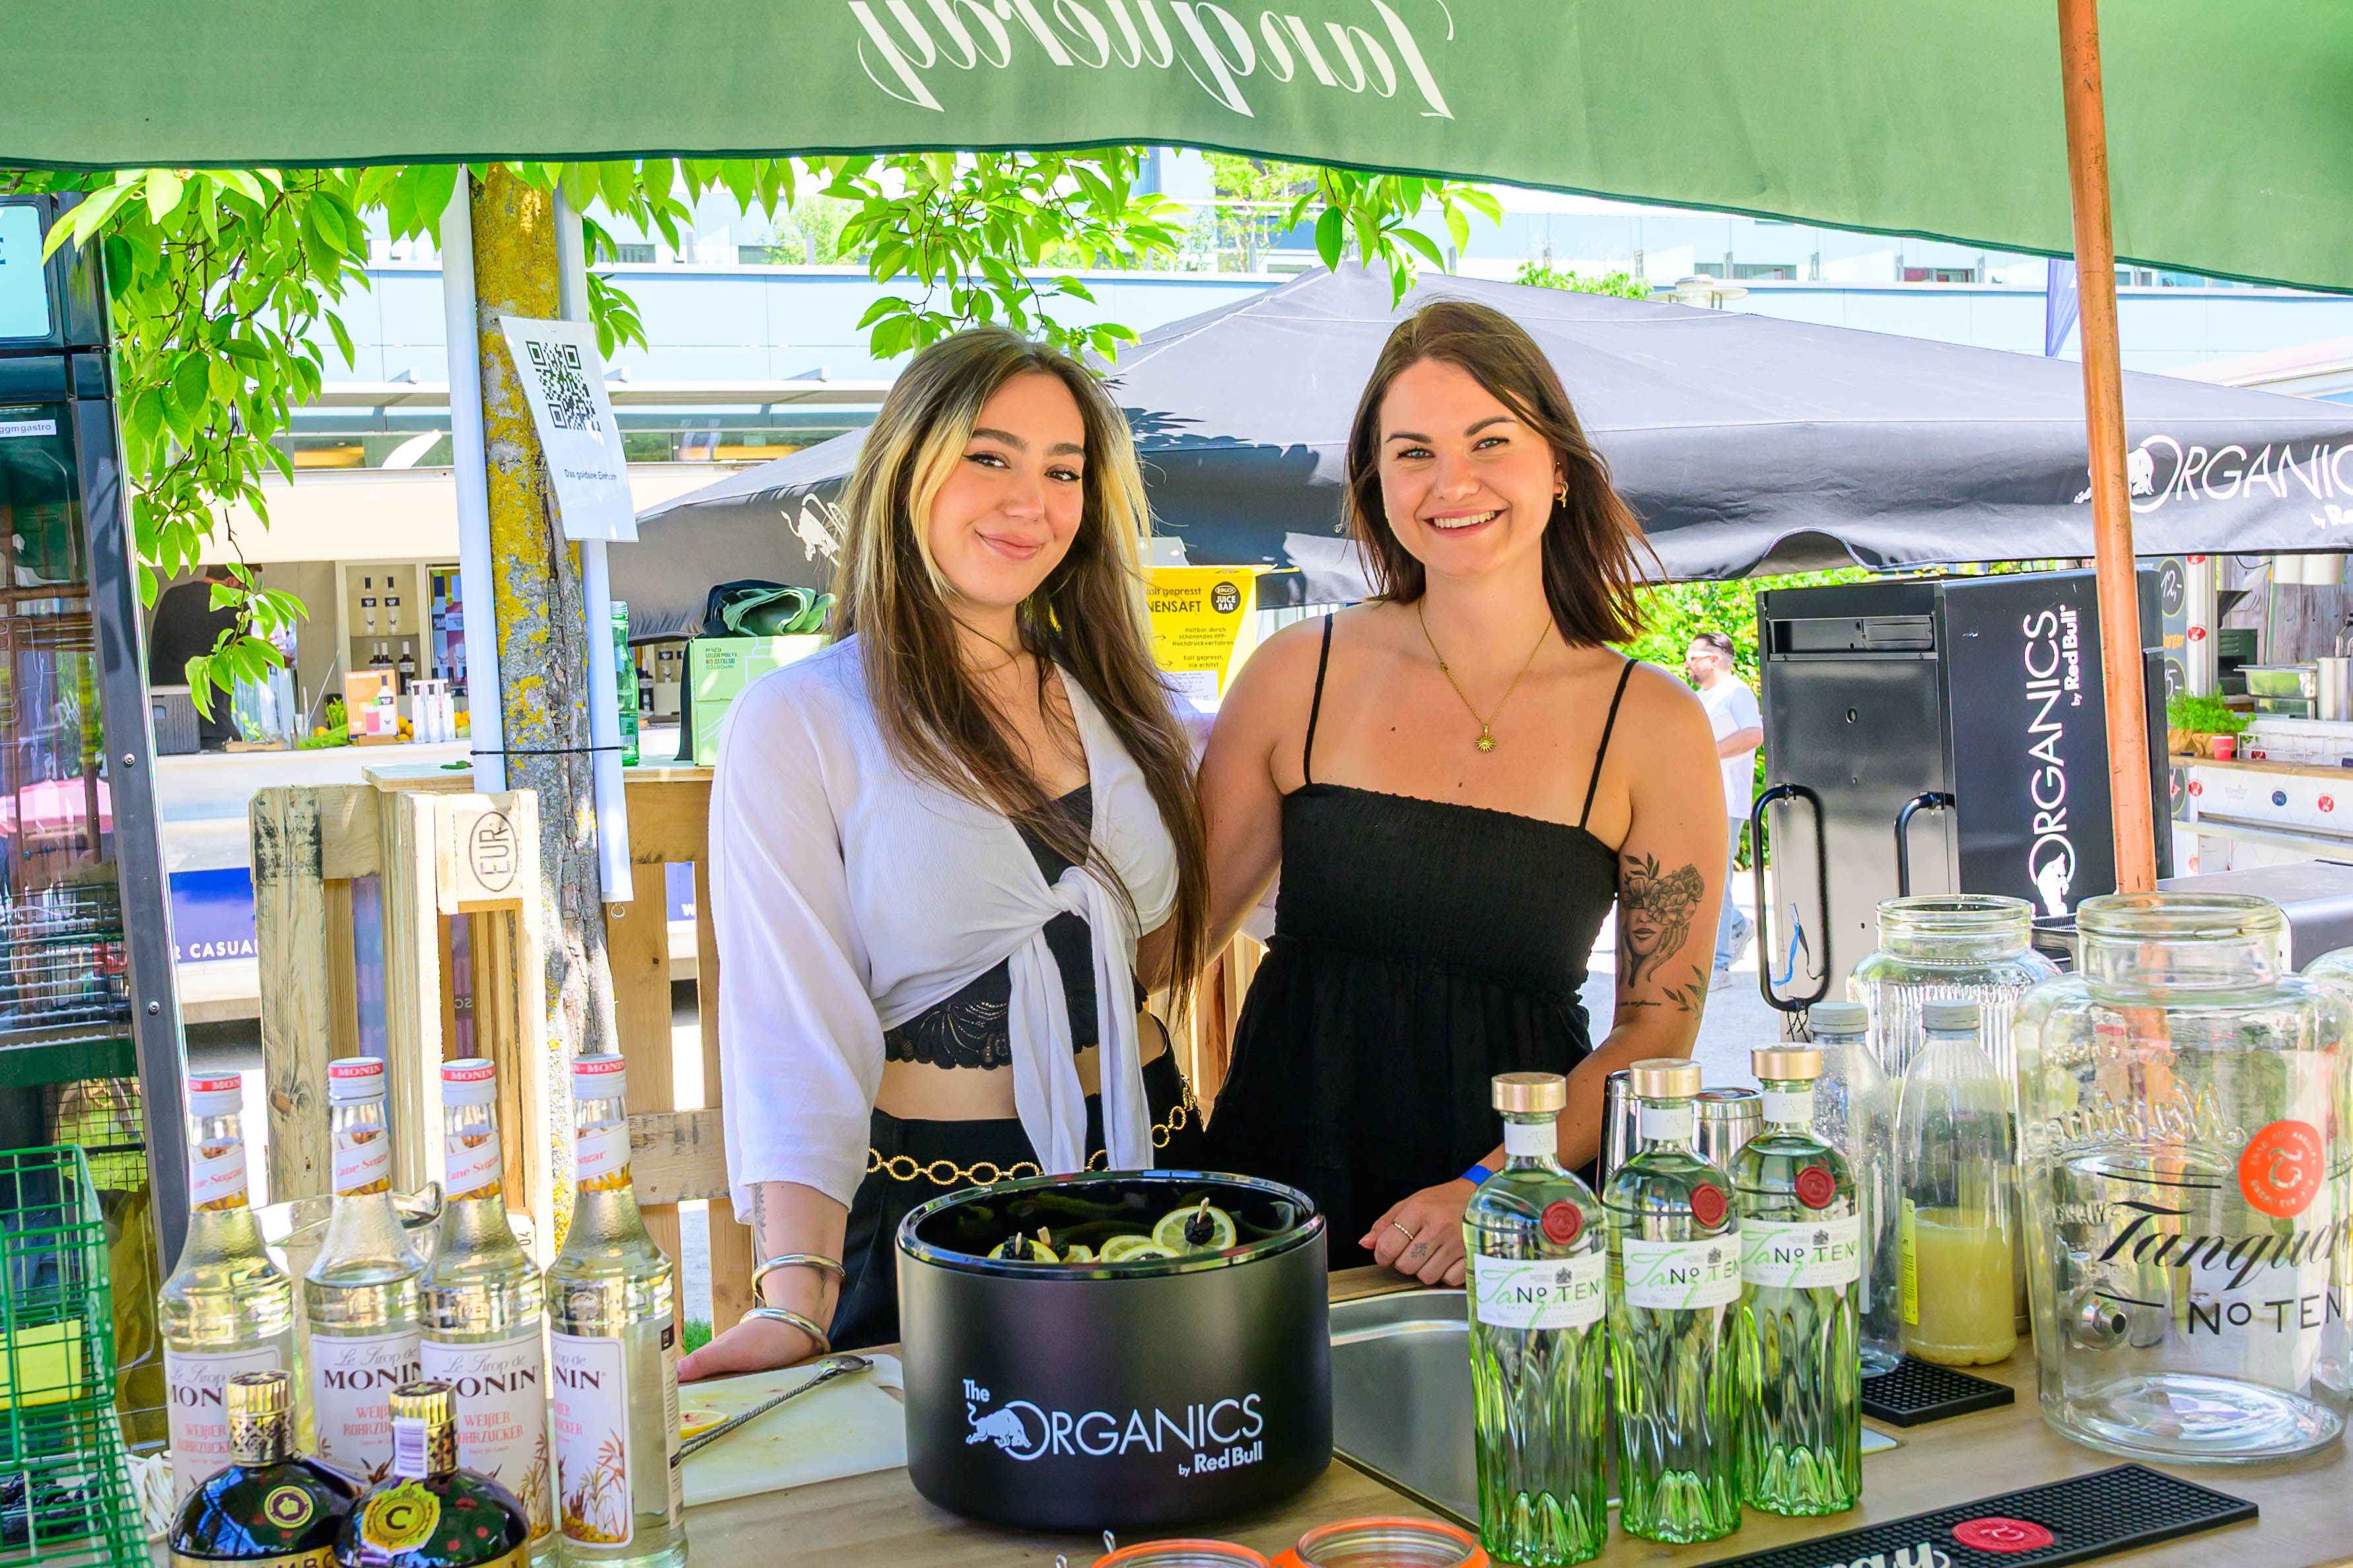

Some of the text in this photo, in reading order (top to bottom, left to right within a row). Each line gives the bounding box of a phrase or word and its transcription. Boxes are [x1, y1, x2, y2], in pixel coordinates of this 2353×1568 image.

[2130, 434, 2353, 513] ORGANIC
[2325, 504, 2353, 526] Re
[1163, 587, 1201, 597] gepresst
[1216, 595, 1236, 603] JUICE
[2060, 610, 2082, 706] by Red Bull
[2023, 611, 2075, 885] ORGANICS
[479, 828, 510, 875] EUR
[450, 1068, 493, 1080] MONIN
[1556, 1278, 1601, 1302] TEN
[2265, 1286, 2342, 1334] TEN
[434, 1365, 536, 1398] ONIN
[553, 1365, 600, 1389] NIN
[963, 1379, 990, 1402] The
[1004, 1393, 1263, 1461] ORGANICS
[1179, 1441, 1263, 1477] by Red Bull
